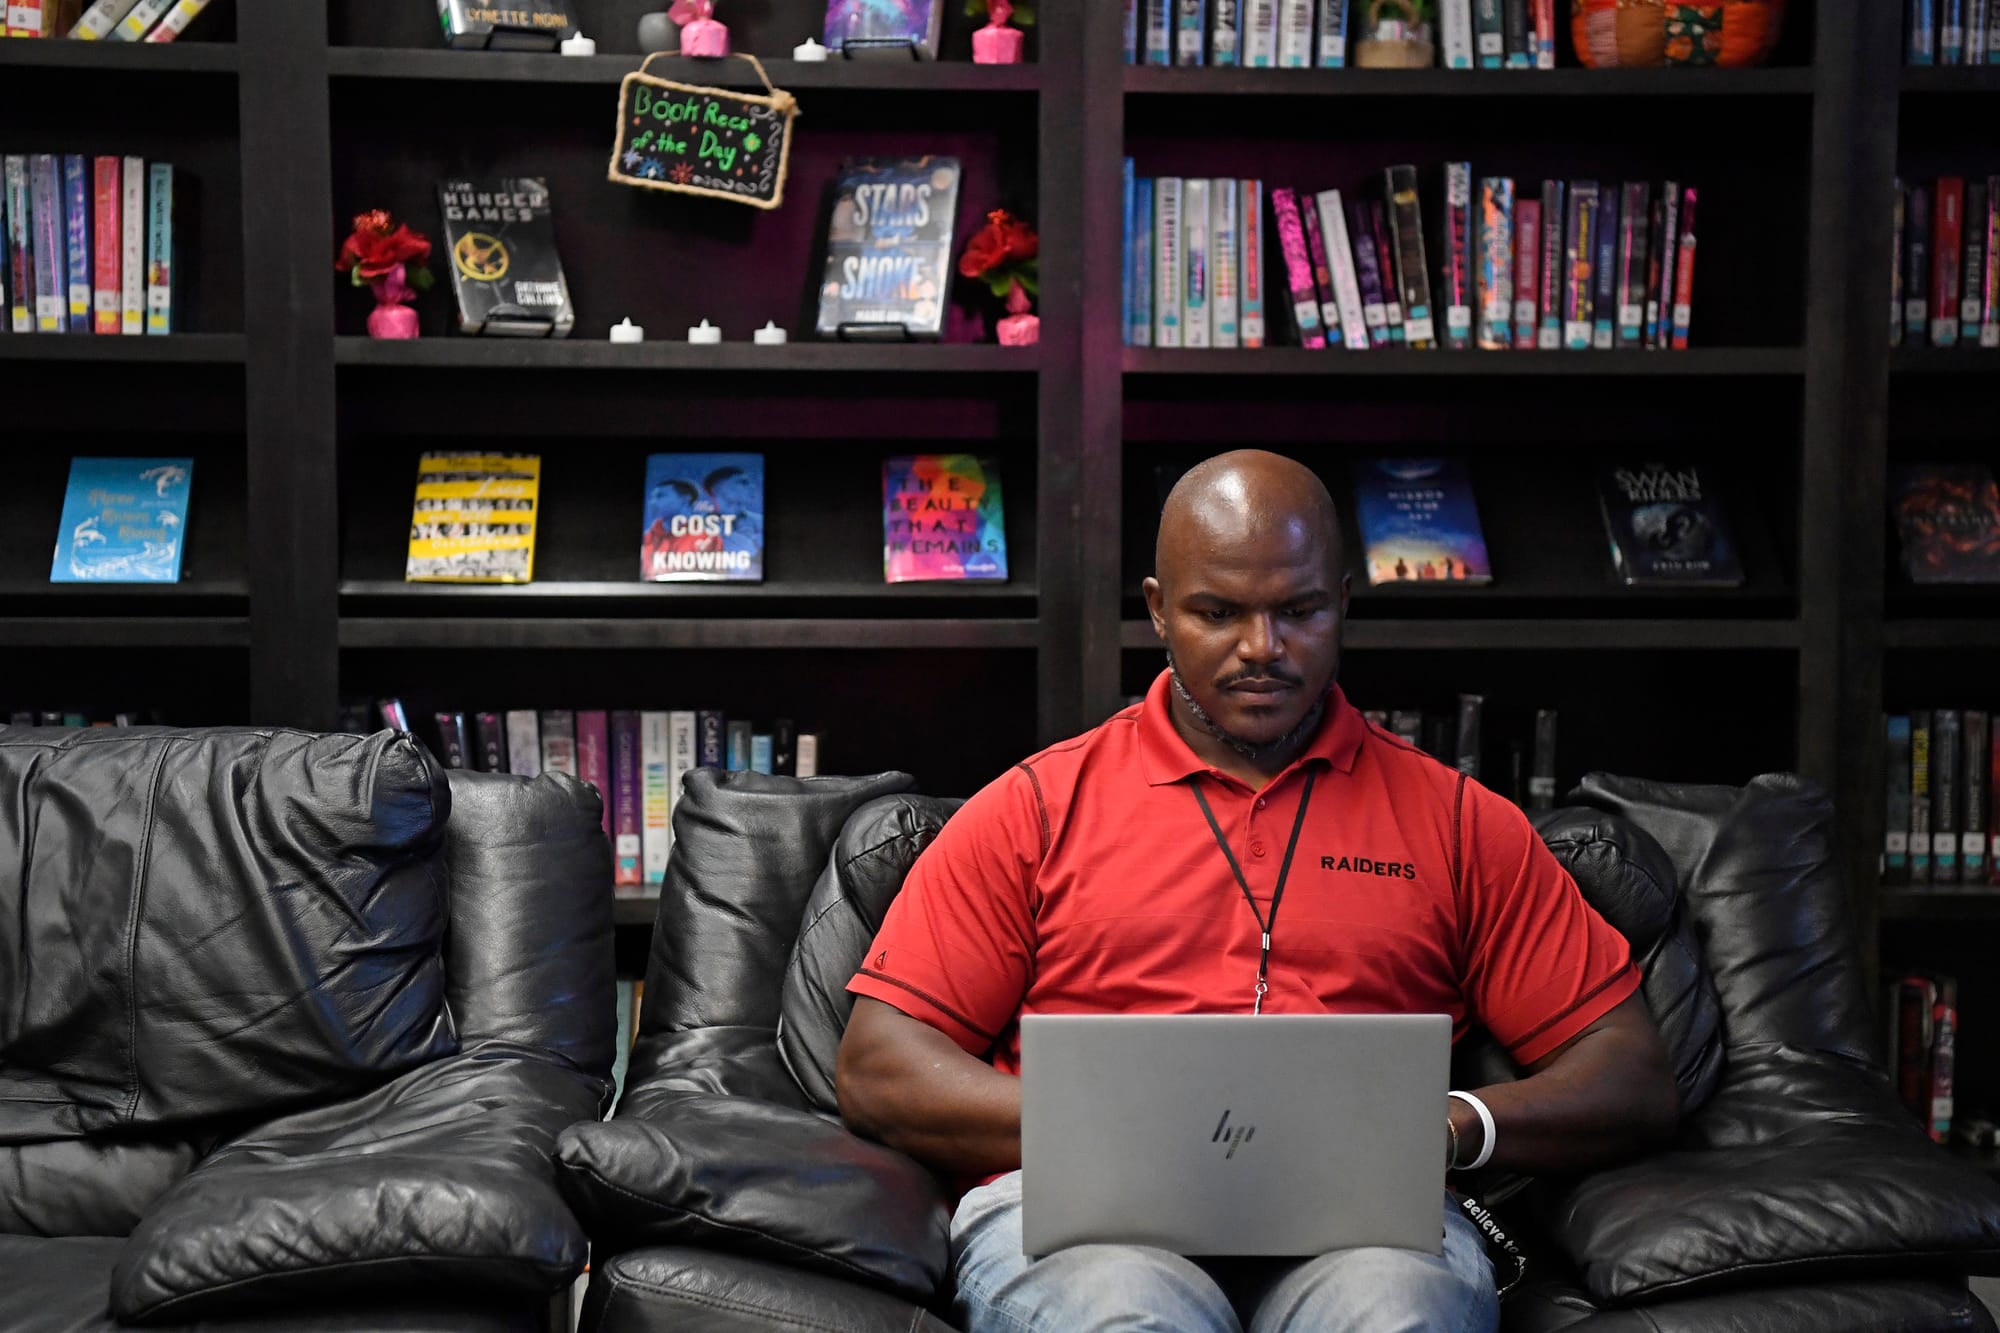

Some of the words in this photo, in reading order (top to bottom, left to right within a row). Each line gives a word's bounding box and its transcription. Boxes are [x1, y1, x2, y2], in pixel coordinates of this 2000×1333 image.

[634, 85, 700, 123] Book
[703, 102, 750, 131] Recs
[632, 130, 653, 149] of
[656, 132, 687, 154] the
[699, 130, 736, 171] Day
[443, 192, 545, 208] HUNGER
[853, 184, 931, 227] STARS
[446, 206, 532, 222] GAMES
[840, 255, 926, 300] SMOKE
[671, 514, 737, 537] COST
[890, 520, 967, 533] THAT
[891, 539, 999, 554] REMAINS
[653, 550, 750, 570] KNOWING
[1320, 856, 1416, 880] RAIDERS
[1212, 1109, 1256, 1160] hp
[1463, 1198, 1505, 1243] Believe
[1503, 1240, 1520, 1253] to
